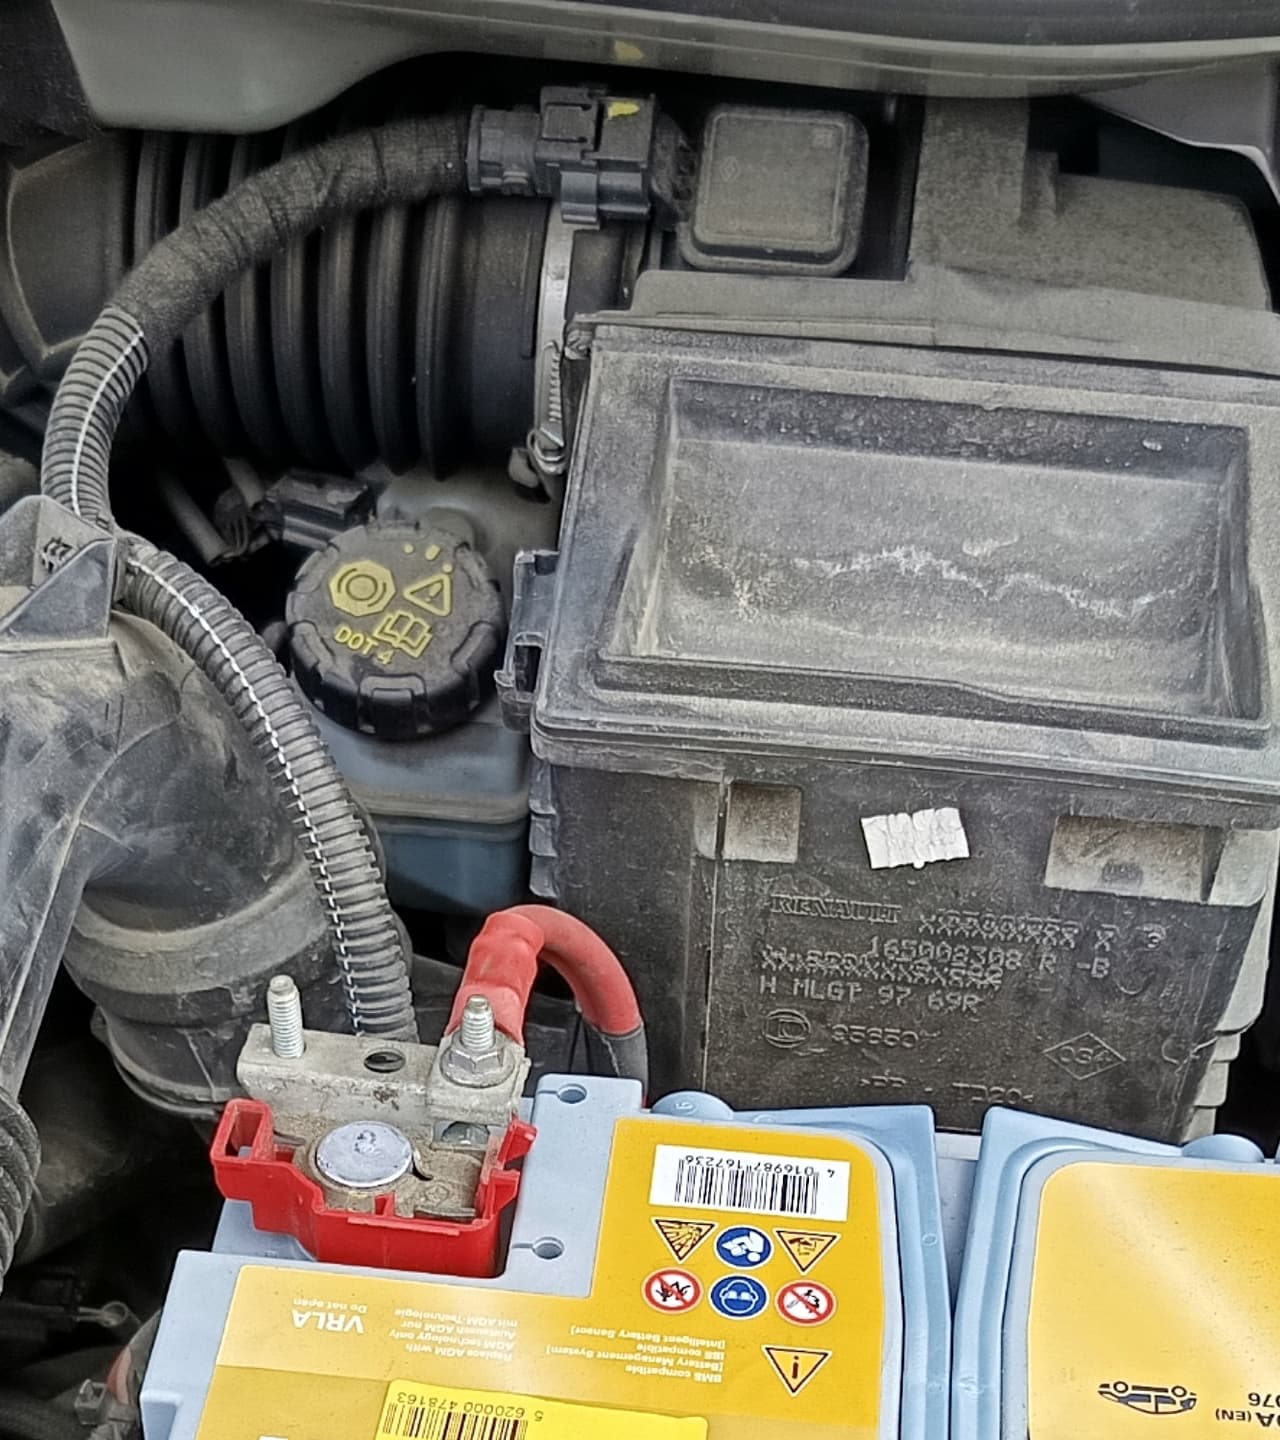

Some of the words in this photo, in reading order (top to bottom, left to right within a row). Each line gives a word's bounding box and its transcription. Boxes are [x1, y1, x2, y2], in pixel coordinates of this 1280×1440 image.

[335, 626, 378, 656] DOT
[376, 648, 394, 665] 4
[770, 893, 903, 924] RENAULT
[683, 1155, 744, 1171] 167236
[753, 1162, 816, 1178] 016987
[293, 1298, 325, 1309] open
[327, 1301, 348, 1311] not
[350, 1304, 368, 1314] Do
[291, 1308, 365, 1334] VRLA
[405, 1343, 433, 1353] with
[396, 1391, 459, 1410] 478163
[462, 1400, 526, 1419] 620000
[533, 1409, 545, 1421] 5
